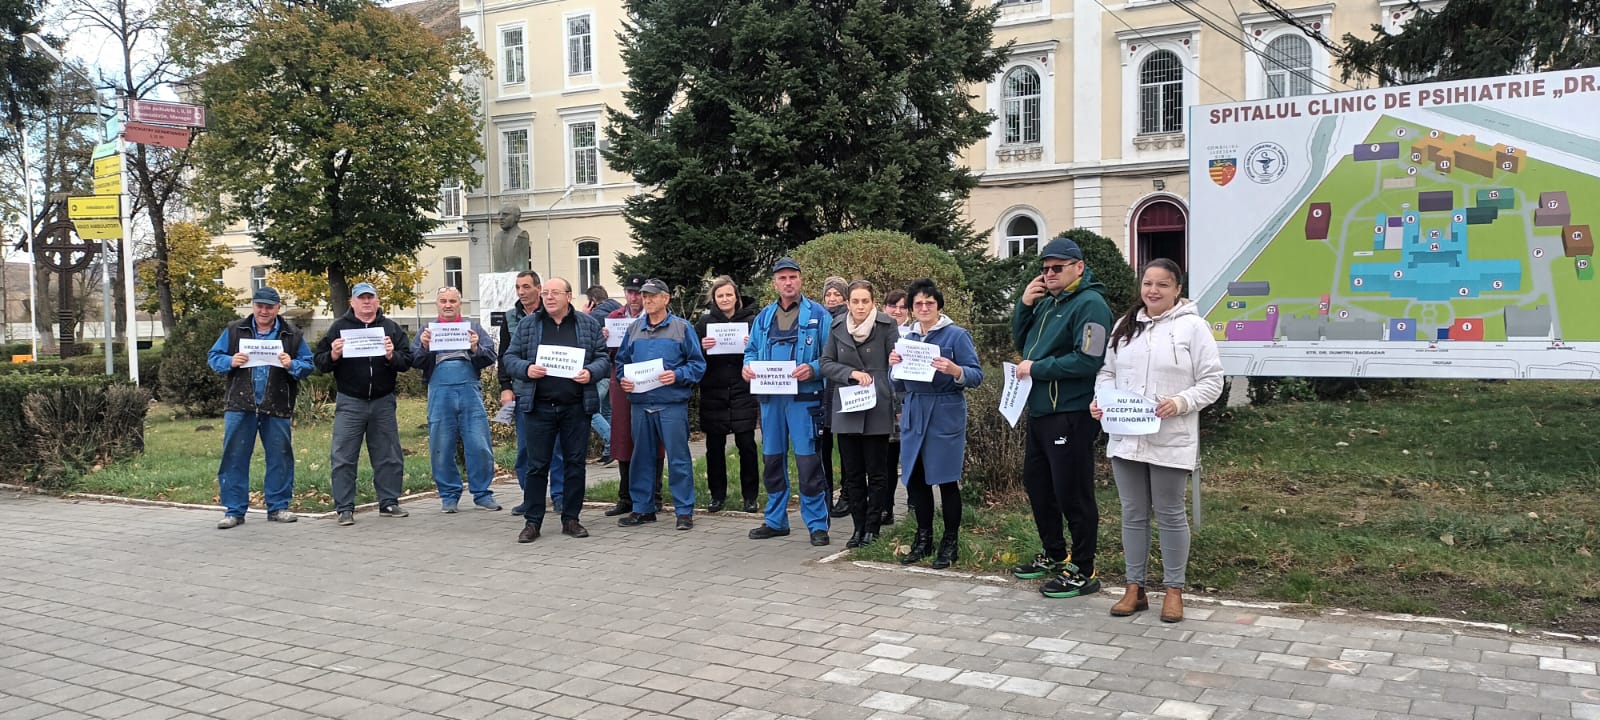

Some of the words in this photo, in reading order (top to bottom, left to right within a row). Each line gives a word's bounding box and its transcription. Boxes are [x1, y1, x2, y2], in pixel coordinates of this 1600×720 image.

[1210, 102, 1301, 124] SPITALUL
[1308, 95, 1376, 116] CLINIC
[1384, 92, 1411, 110] DE
[1418, 79, 1545, 106] PSIHIATRIE
